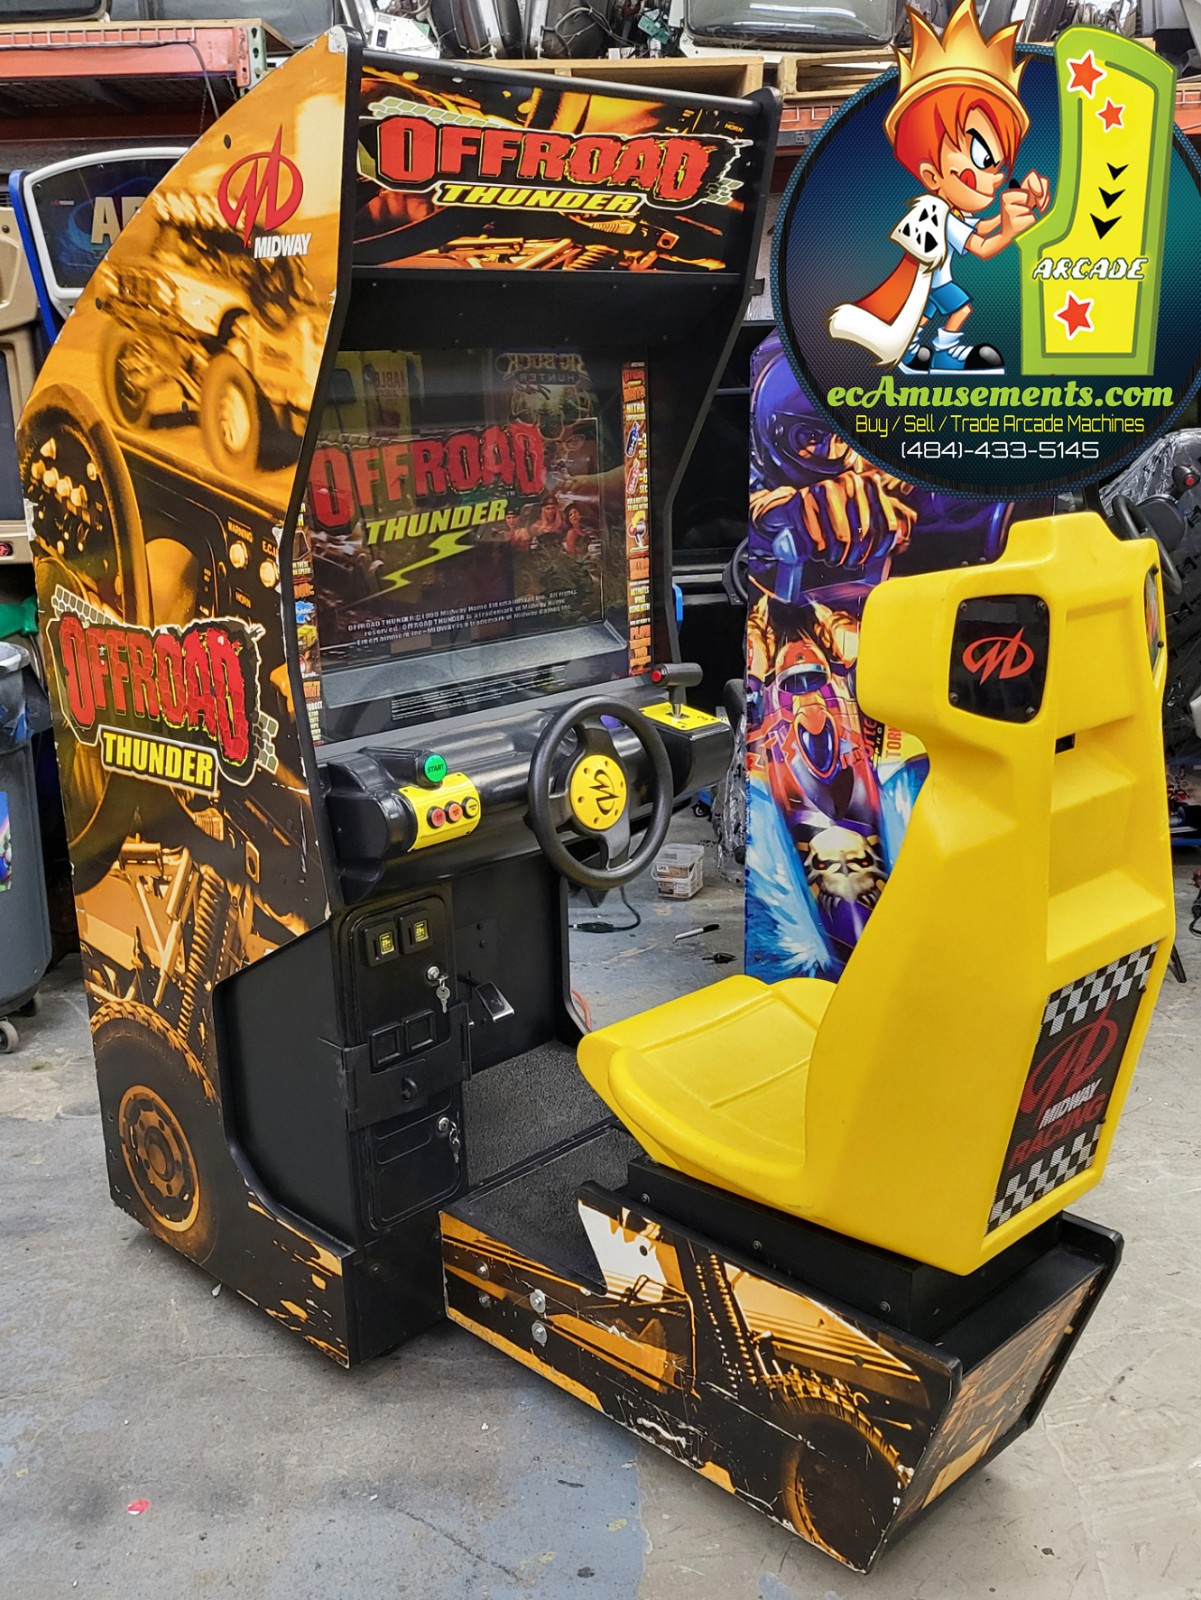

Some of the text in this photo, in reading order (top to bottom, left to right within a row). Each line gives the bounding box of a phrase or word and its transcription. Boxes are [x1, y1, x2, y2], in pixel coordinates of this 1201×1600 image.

[378, 116, 711, 201] OFFROAD
[442, 184, 638, 212] THUNDER
[254, 233, 312, 259] MIDWAY
[309, 423, 547, 527] OFFROAD
[366, 499, 508, 545] THUNDER
[59, 616, 249, 766] OFFROAD
[104, 732, 214, 787] THUNDER
[427, 764, 444, 773] START
[1038, 1078, 1102, 1130] MIDWAY
[1007, 1093, 1106, 1170] RACING
